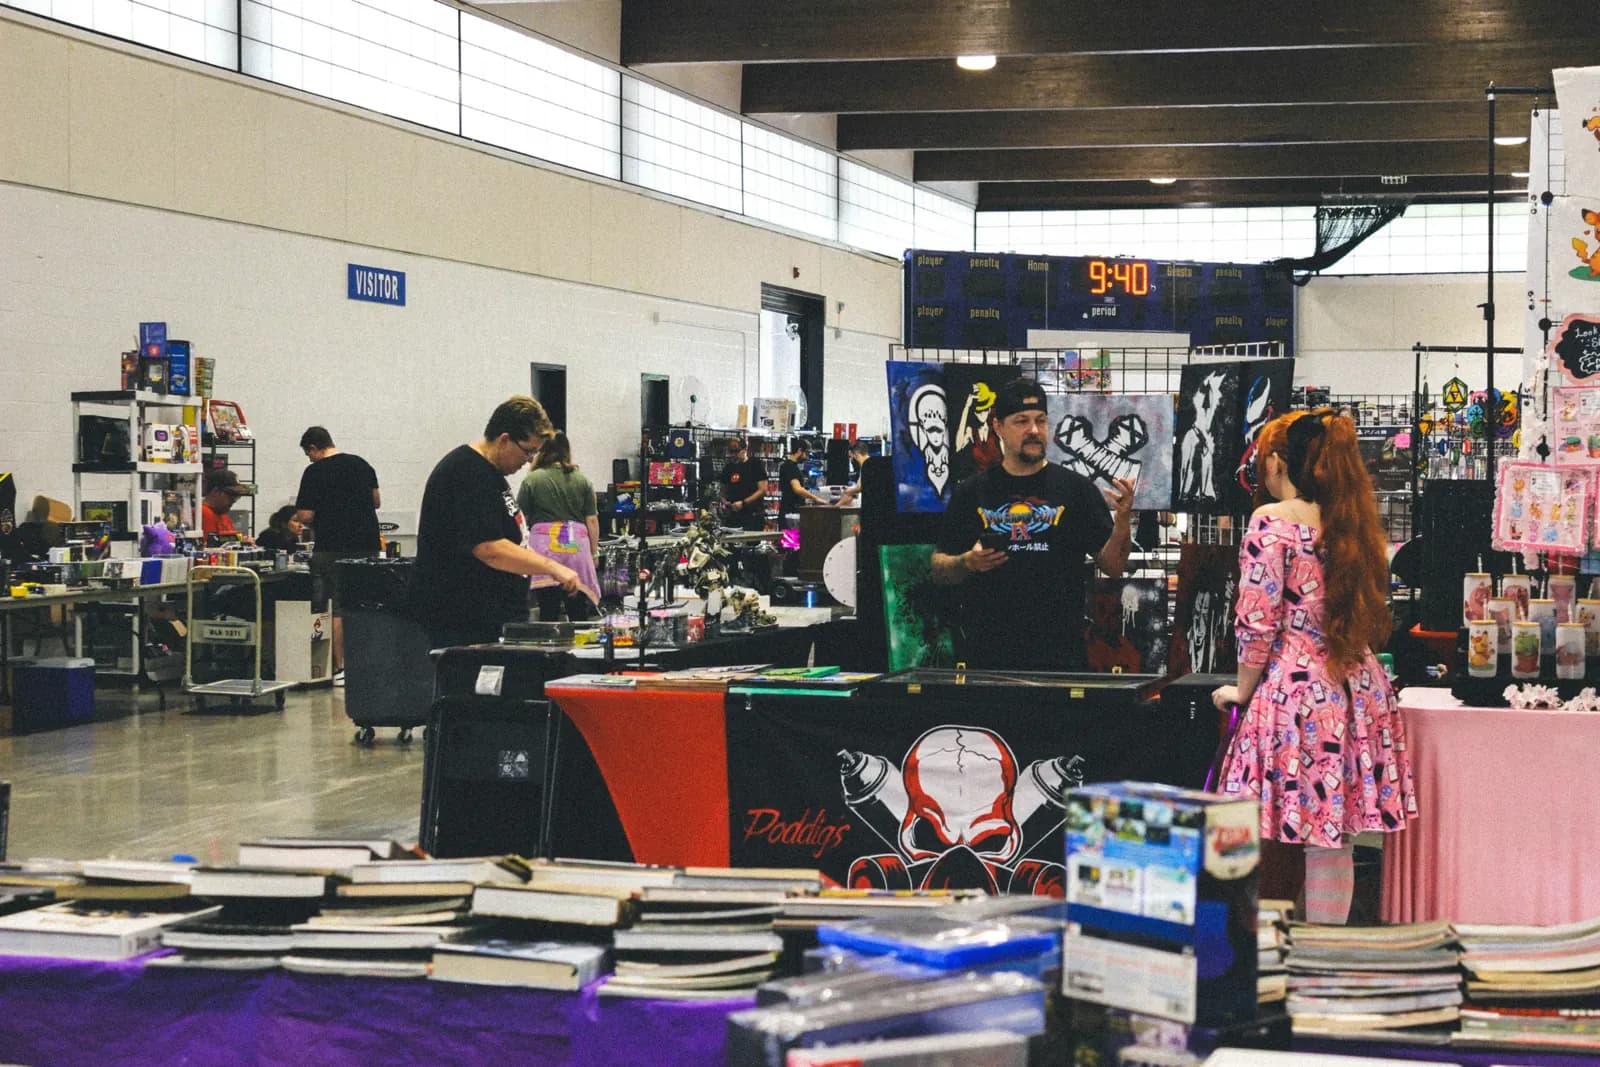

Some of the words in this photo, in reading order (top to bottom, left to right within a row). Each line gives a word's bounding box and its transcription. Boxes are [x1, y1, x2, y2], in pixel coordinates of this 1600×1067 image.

[917, 255, 944, 267] player
[970, 257, 1000, 269] penalty
[1027, 259, 1049, 271] Home
[1089, 261, 1148, 295] 9:40
[356, 269, 399, 300] VISITOR
[917, 305, 944, 317] player
[970, 307, 1000, 319] penalty
[1091, 305, 1117, 317] period
